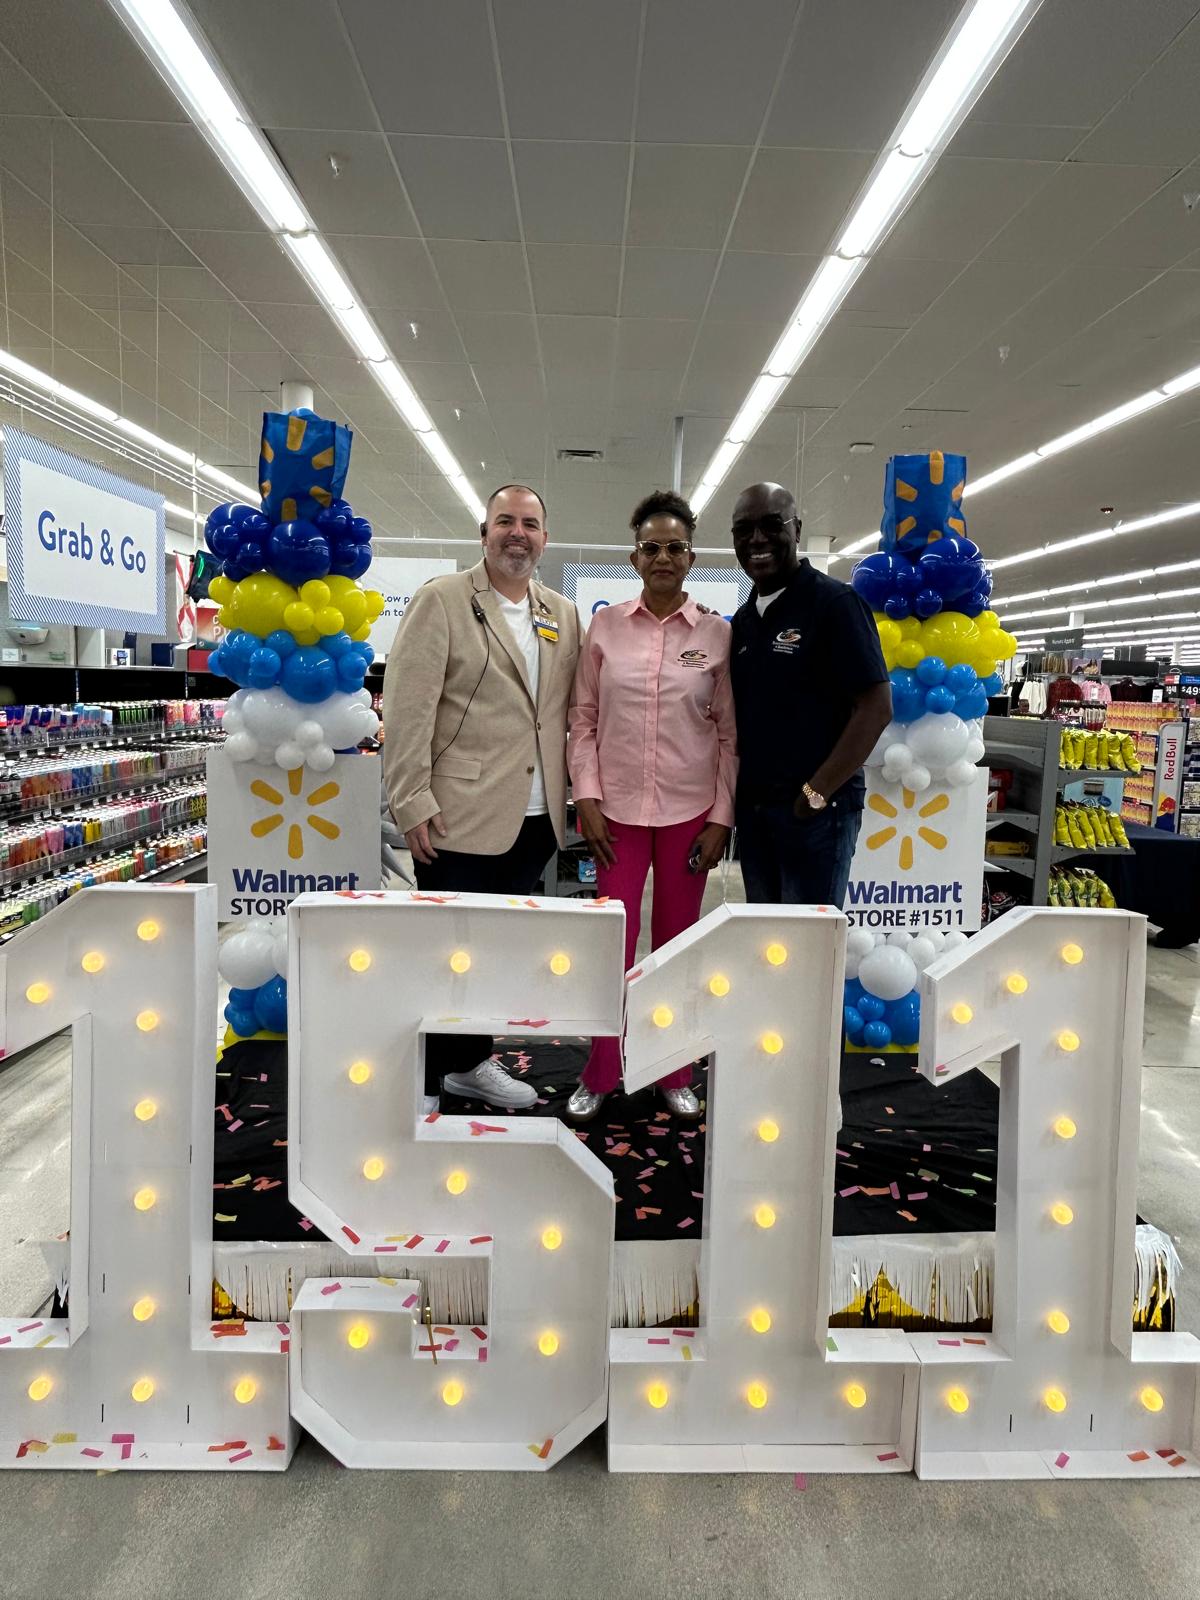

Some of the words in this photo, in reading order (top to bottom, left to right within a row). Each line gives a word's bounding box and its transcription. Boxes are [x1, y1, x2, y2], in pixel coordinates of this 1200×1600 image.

[38, 510, 93, 561] Grab
[100, 529, 115, 566] &
[120, 536, 146, 573] Go
[1165, 738, 1177, 758] Bull
[1163, 759, 1175, 781] Red
[232, 868, 359, 894] Walmart
[847, 880, 963, 905] Walmart
[230, 898, 294, 916] STOR
[845, 909, 906, 927] STORE
[908, 908, 964, 926] #1511
